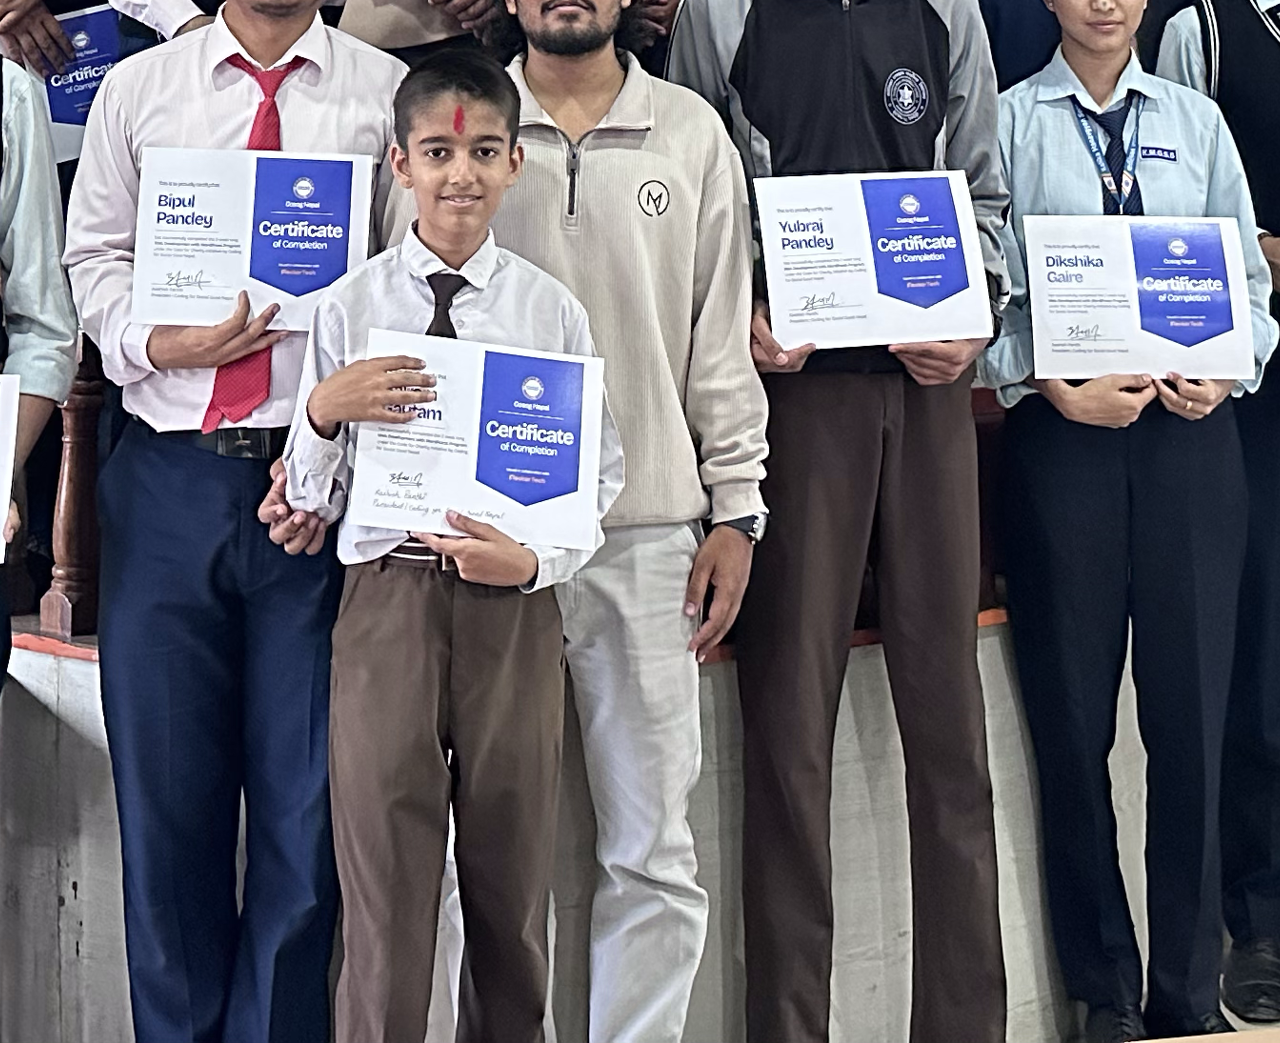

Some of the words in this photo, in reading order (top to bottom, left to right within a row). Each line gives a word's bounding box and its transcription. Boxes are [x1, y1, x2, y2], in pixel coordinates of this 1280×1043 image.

[157, 193, 196, 209] Bipul
[156, 211, 214, 229] Pandey
[778, 218, 824, 234] Yubraj
[259, 220, 344, 238] Certificate
[272, 240, 282, 249] of
[282, 240, 328, 250] Completion
[781, 235, 834, 250] Pandey
[877, 234, 957, 252] Certificate
[893, 254, 902, 263] of
[902, 252, 946, 264] Completion
[1045, 255, 1104, 268] Dikshika
[1047, 270, 1084, 283] Gaire
[1142, 275, 1224, 292] Certificate
[1158, 294, 1167, 302] of
[1167, 294, 1211, 304] Completion
[485, 420, 575, 446] Certificate
[500, 442, 510, 451] of
[510, 442, 558, 456] Completion
